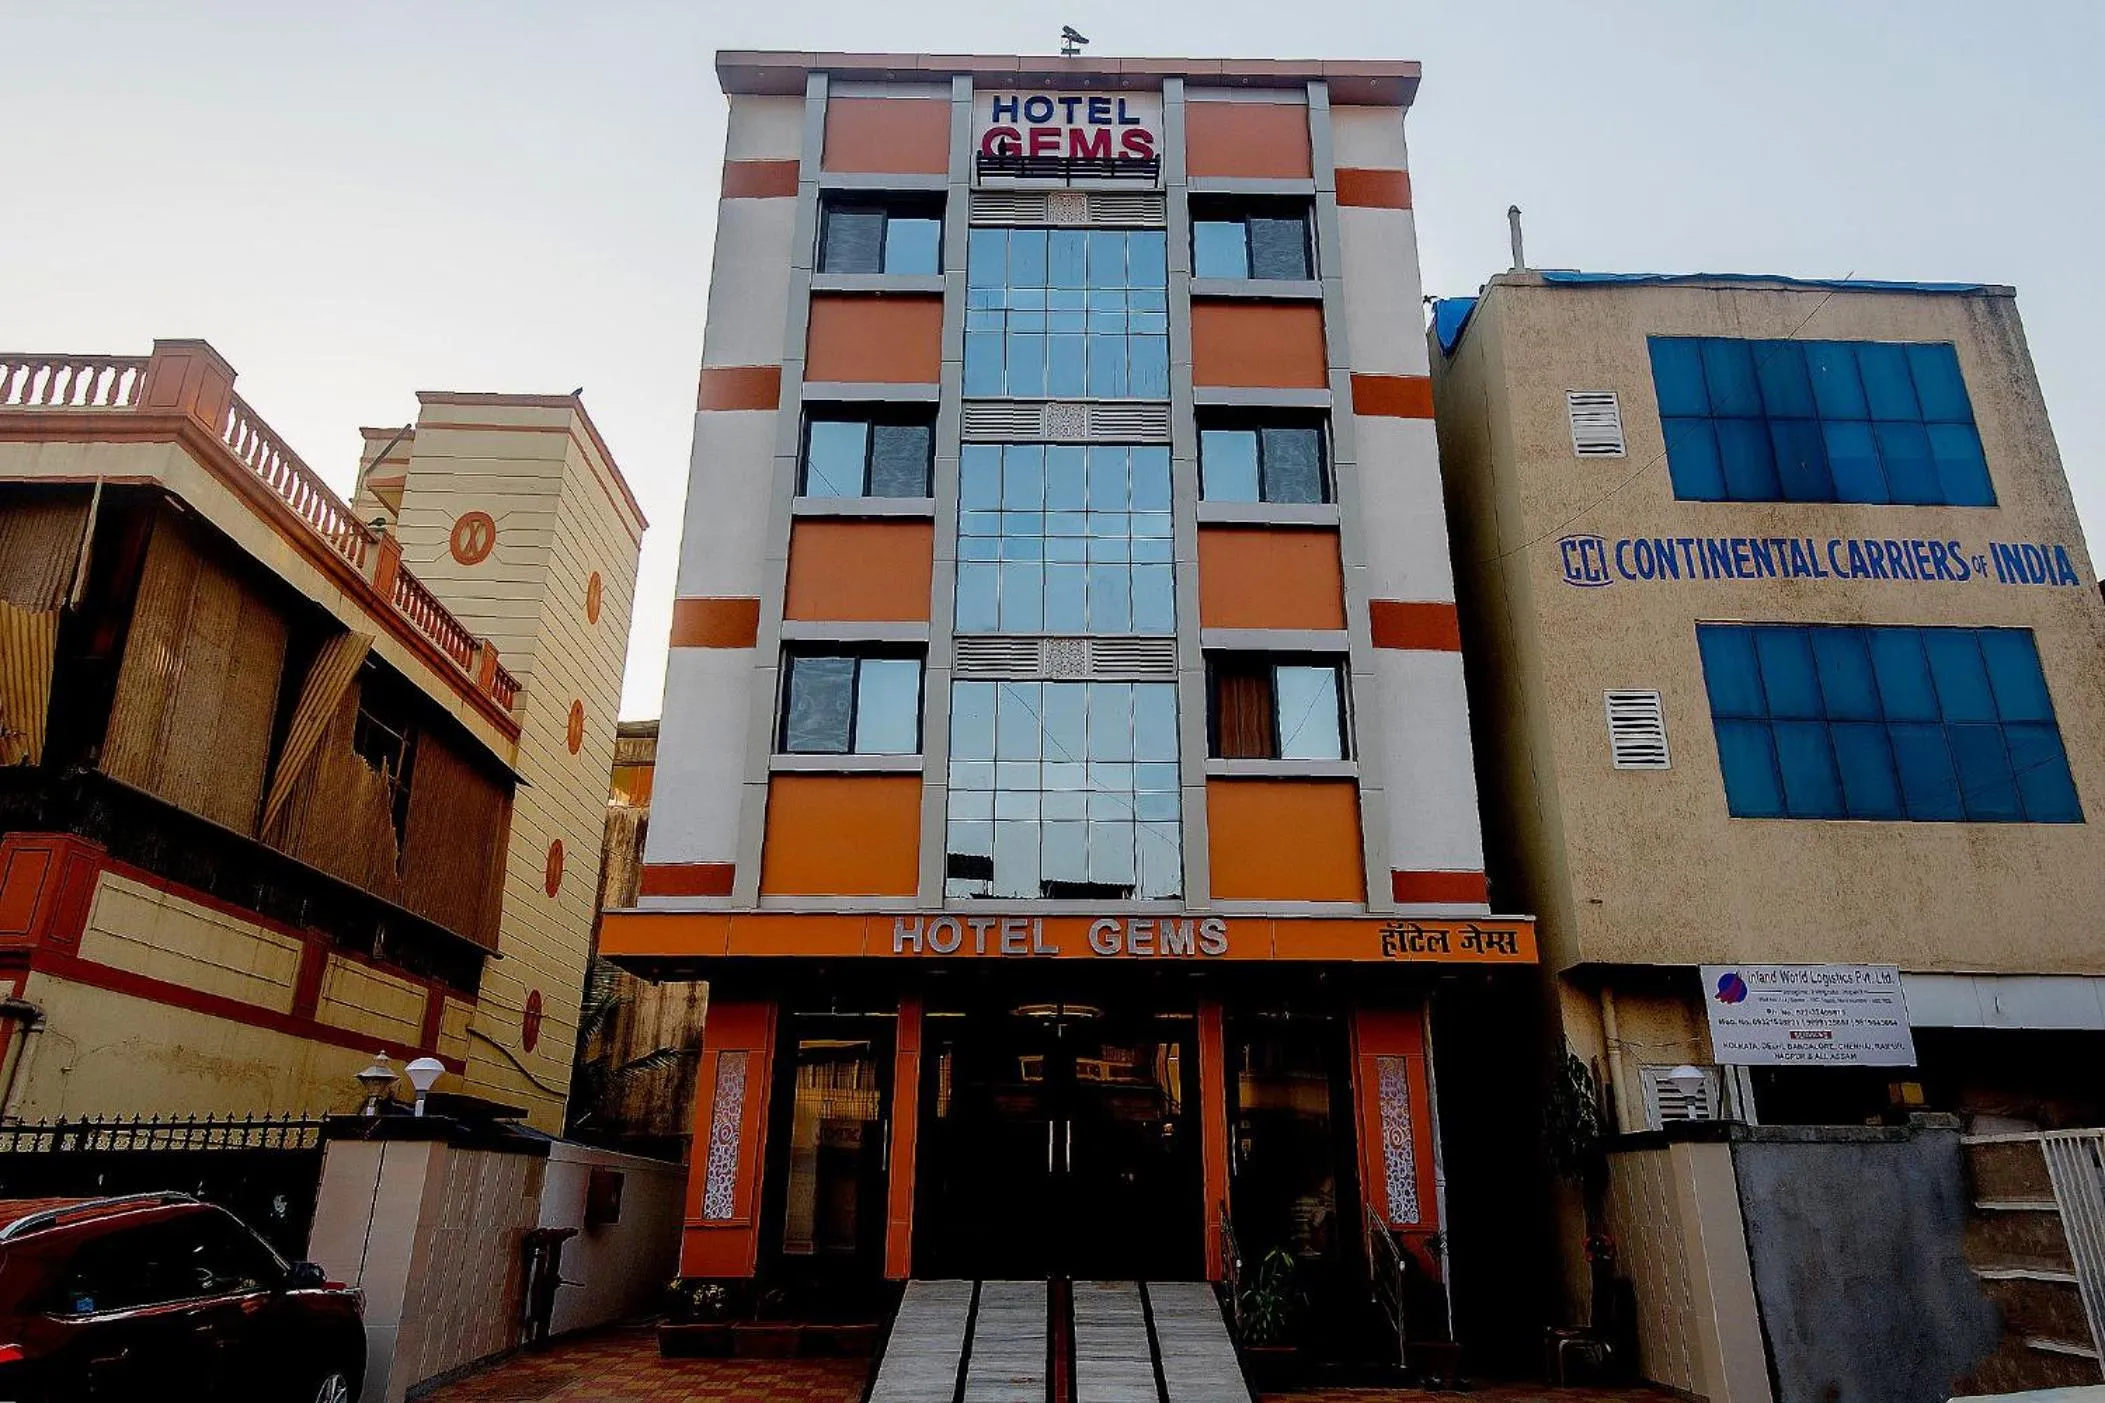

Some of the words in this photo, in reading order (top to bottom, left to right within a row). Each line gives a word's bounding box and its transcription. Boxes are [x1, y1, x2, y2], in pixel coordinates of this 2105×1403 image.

[992, 96, 1140, 125] HOTEL
[982, 126, 1154, 160] GEMS
[1561, 539, 1610, 582] CCI
[1615, 538, 1827, 580] CONTINENTAL
[1828, 539, 1971, 582] CARRIERS
[1972, 554, 1989, 577] OF
[1990, 542, 2080, 586] INDIA
[893, 916, 1059, 955] HOTEL
[1088, 917, 1228, 956] GEMS
[1458, 922, 1518, 955] जेम्स
[1780, 970, 1807, 984] World
[1810, 970, 1853, 987] Logistics
